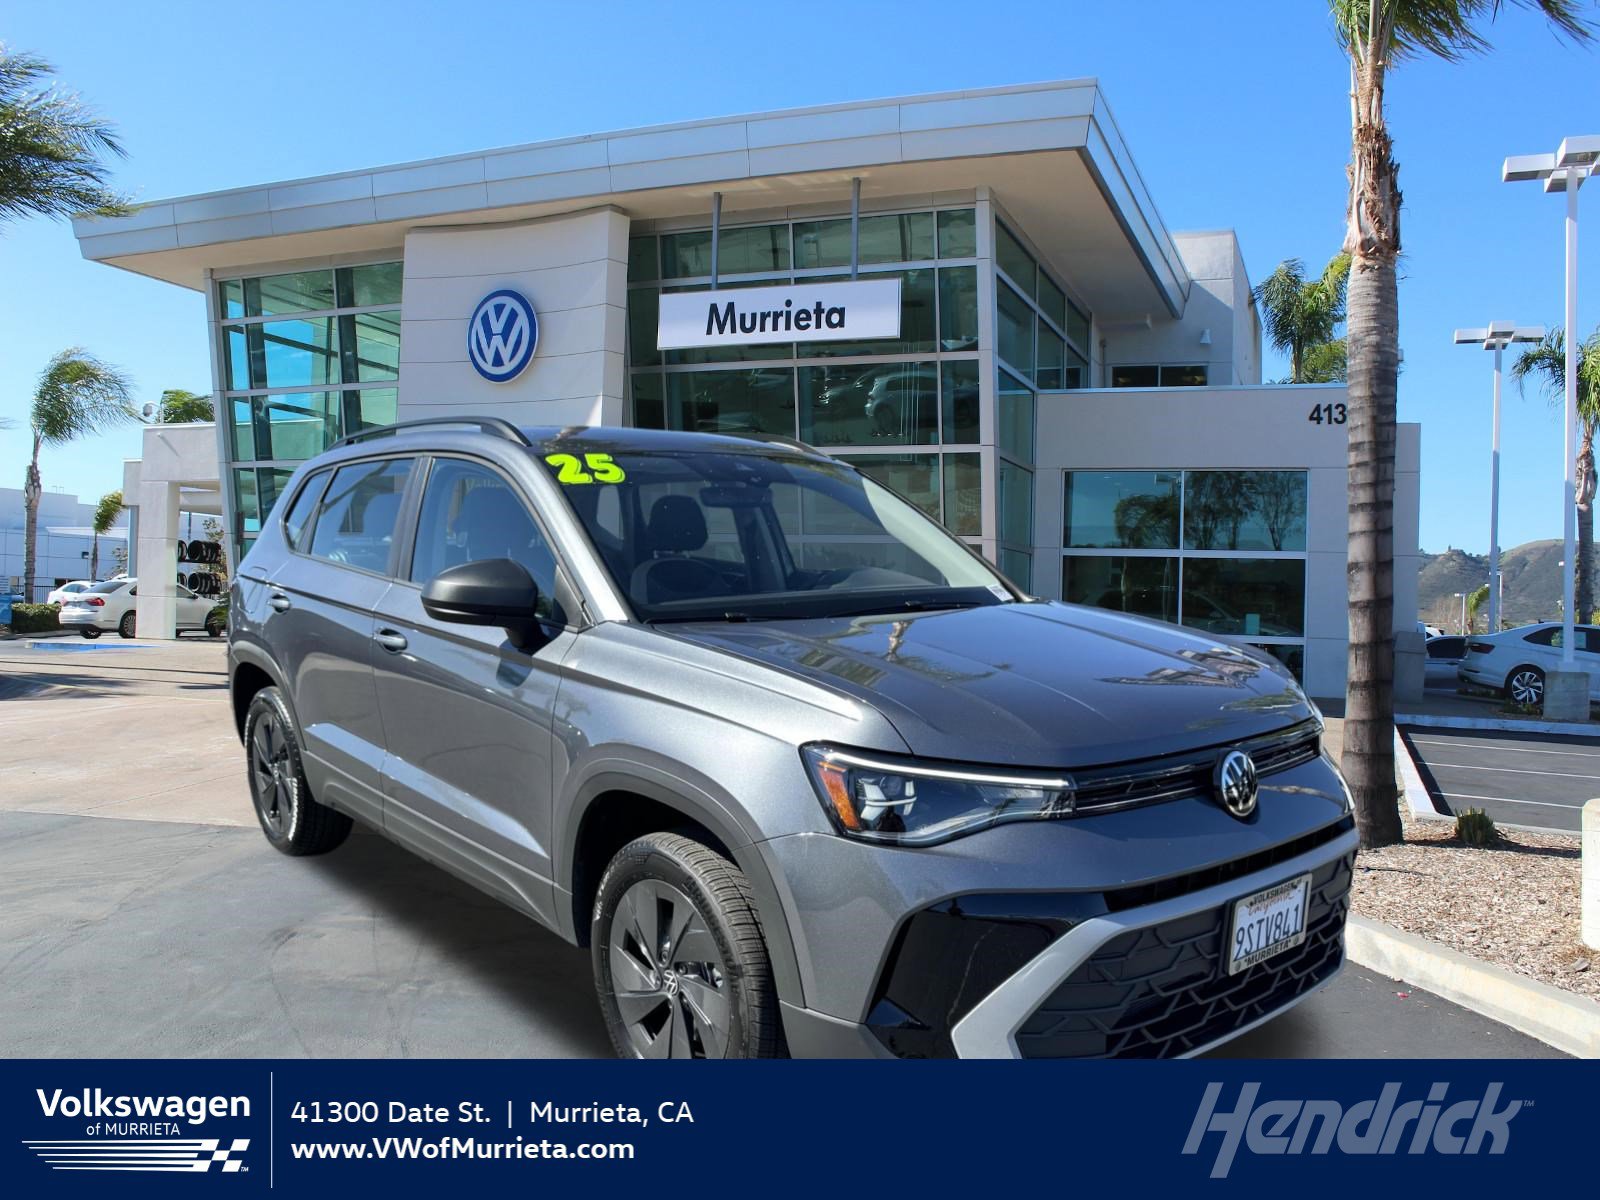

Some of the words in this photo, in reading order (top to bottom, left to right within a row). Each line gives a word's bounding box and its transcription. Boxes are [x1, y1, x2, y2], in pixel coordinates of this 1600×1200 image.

[706, 299, 846, 335] Murrieta
[1308, 403, 1347, 425] 413
[545, 453, 626, 485] 25
[1235, 904, 1300, 961] 9STV841
